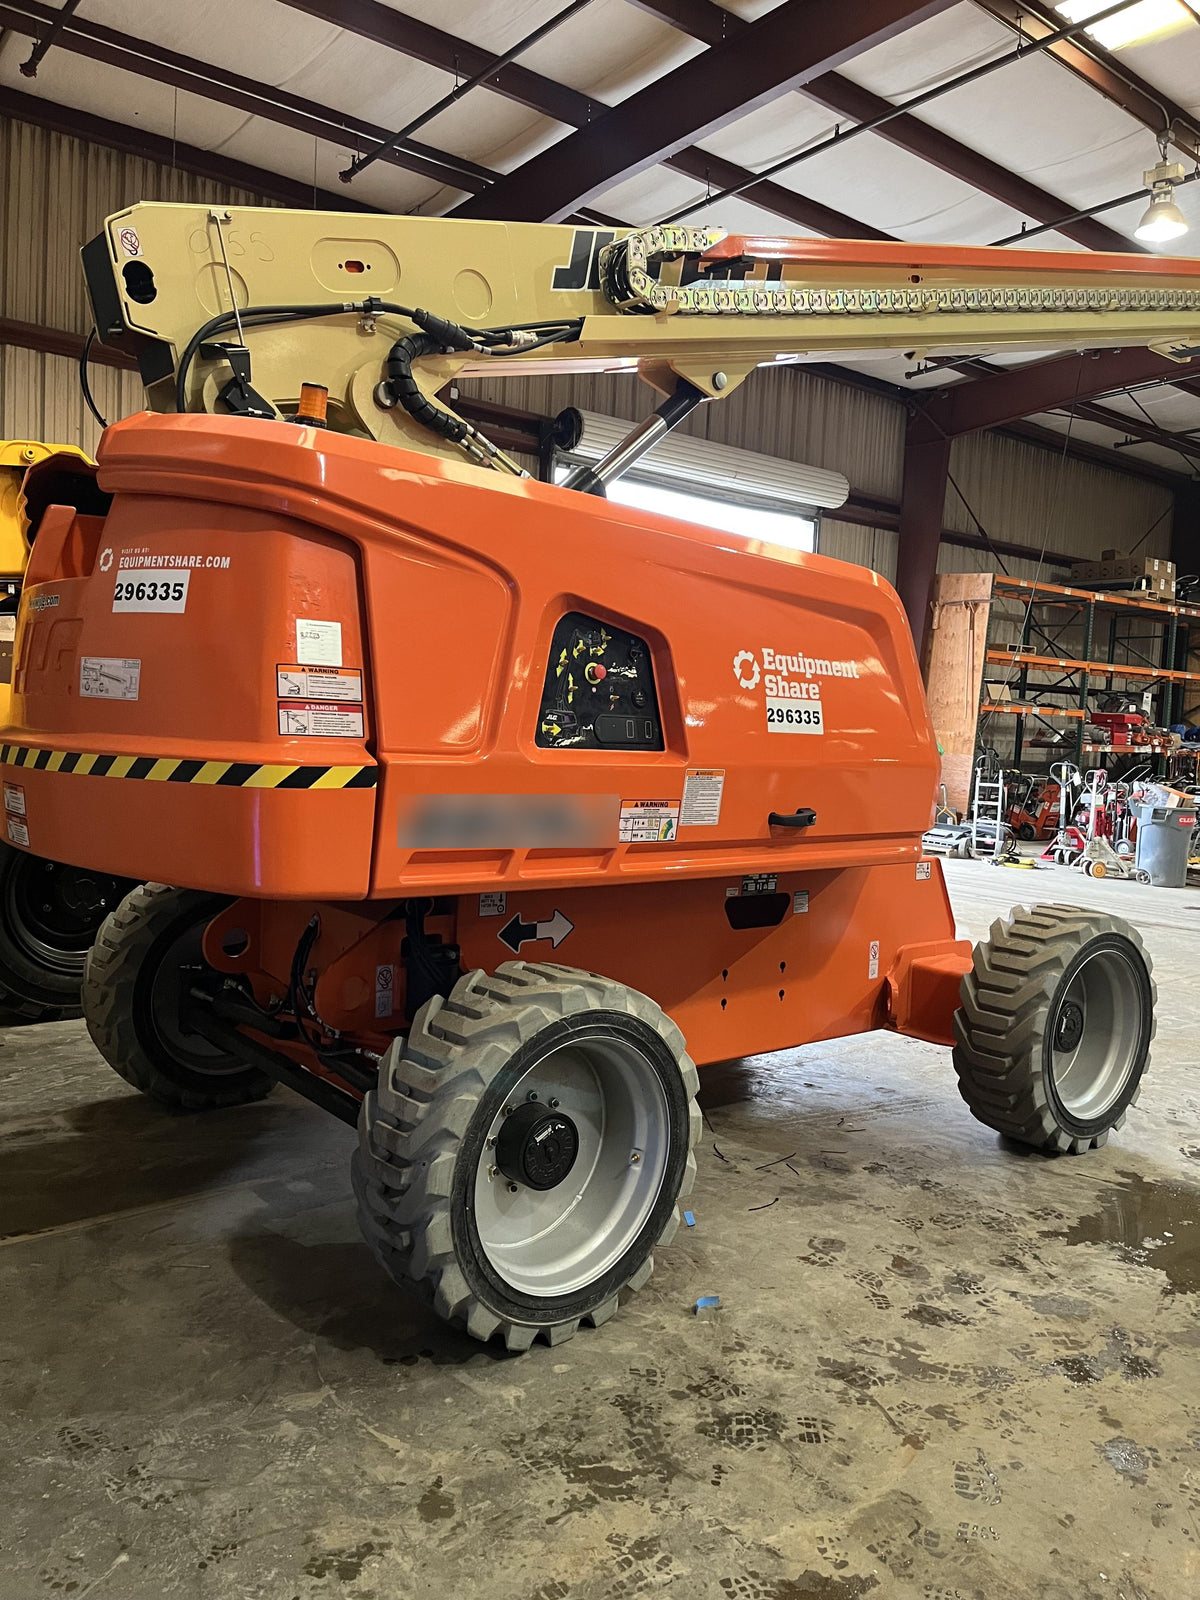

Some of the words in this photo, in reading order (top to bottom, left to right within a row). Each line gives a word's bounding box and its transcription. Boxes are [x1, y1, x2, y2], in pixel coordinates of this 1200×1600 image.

[119, 555, 231, 569] EQUIPMENTSHARE.COM
[113, 582, 184, 601] 296335
[308, 667, 339, 675] WARNING
[761, 647, 860, 679] Equipment
[764, 674, 820, 700] Share
[767, 708, 821, 725] 296335
